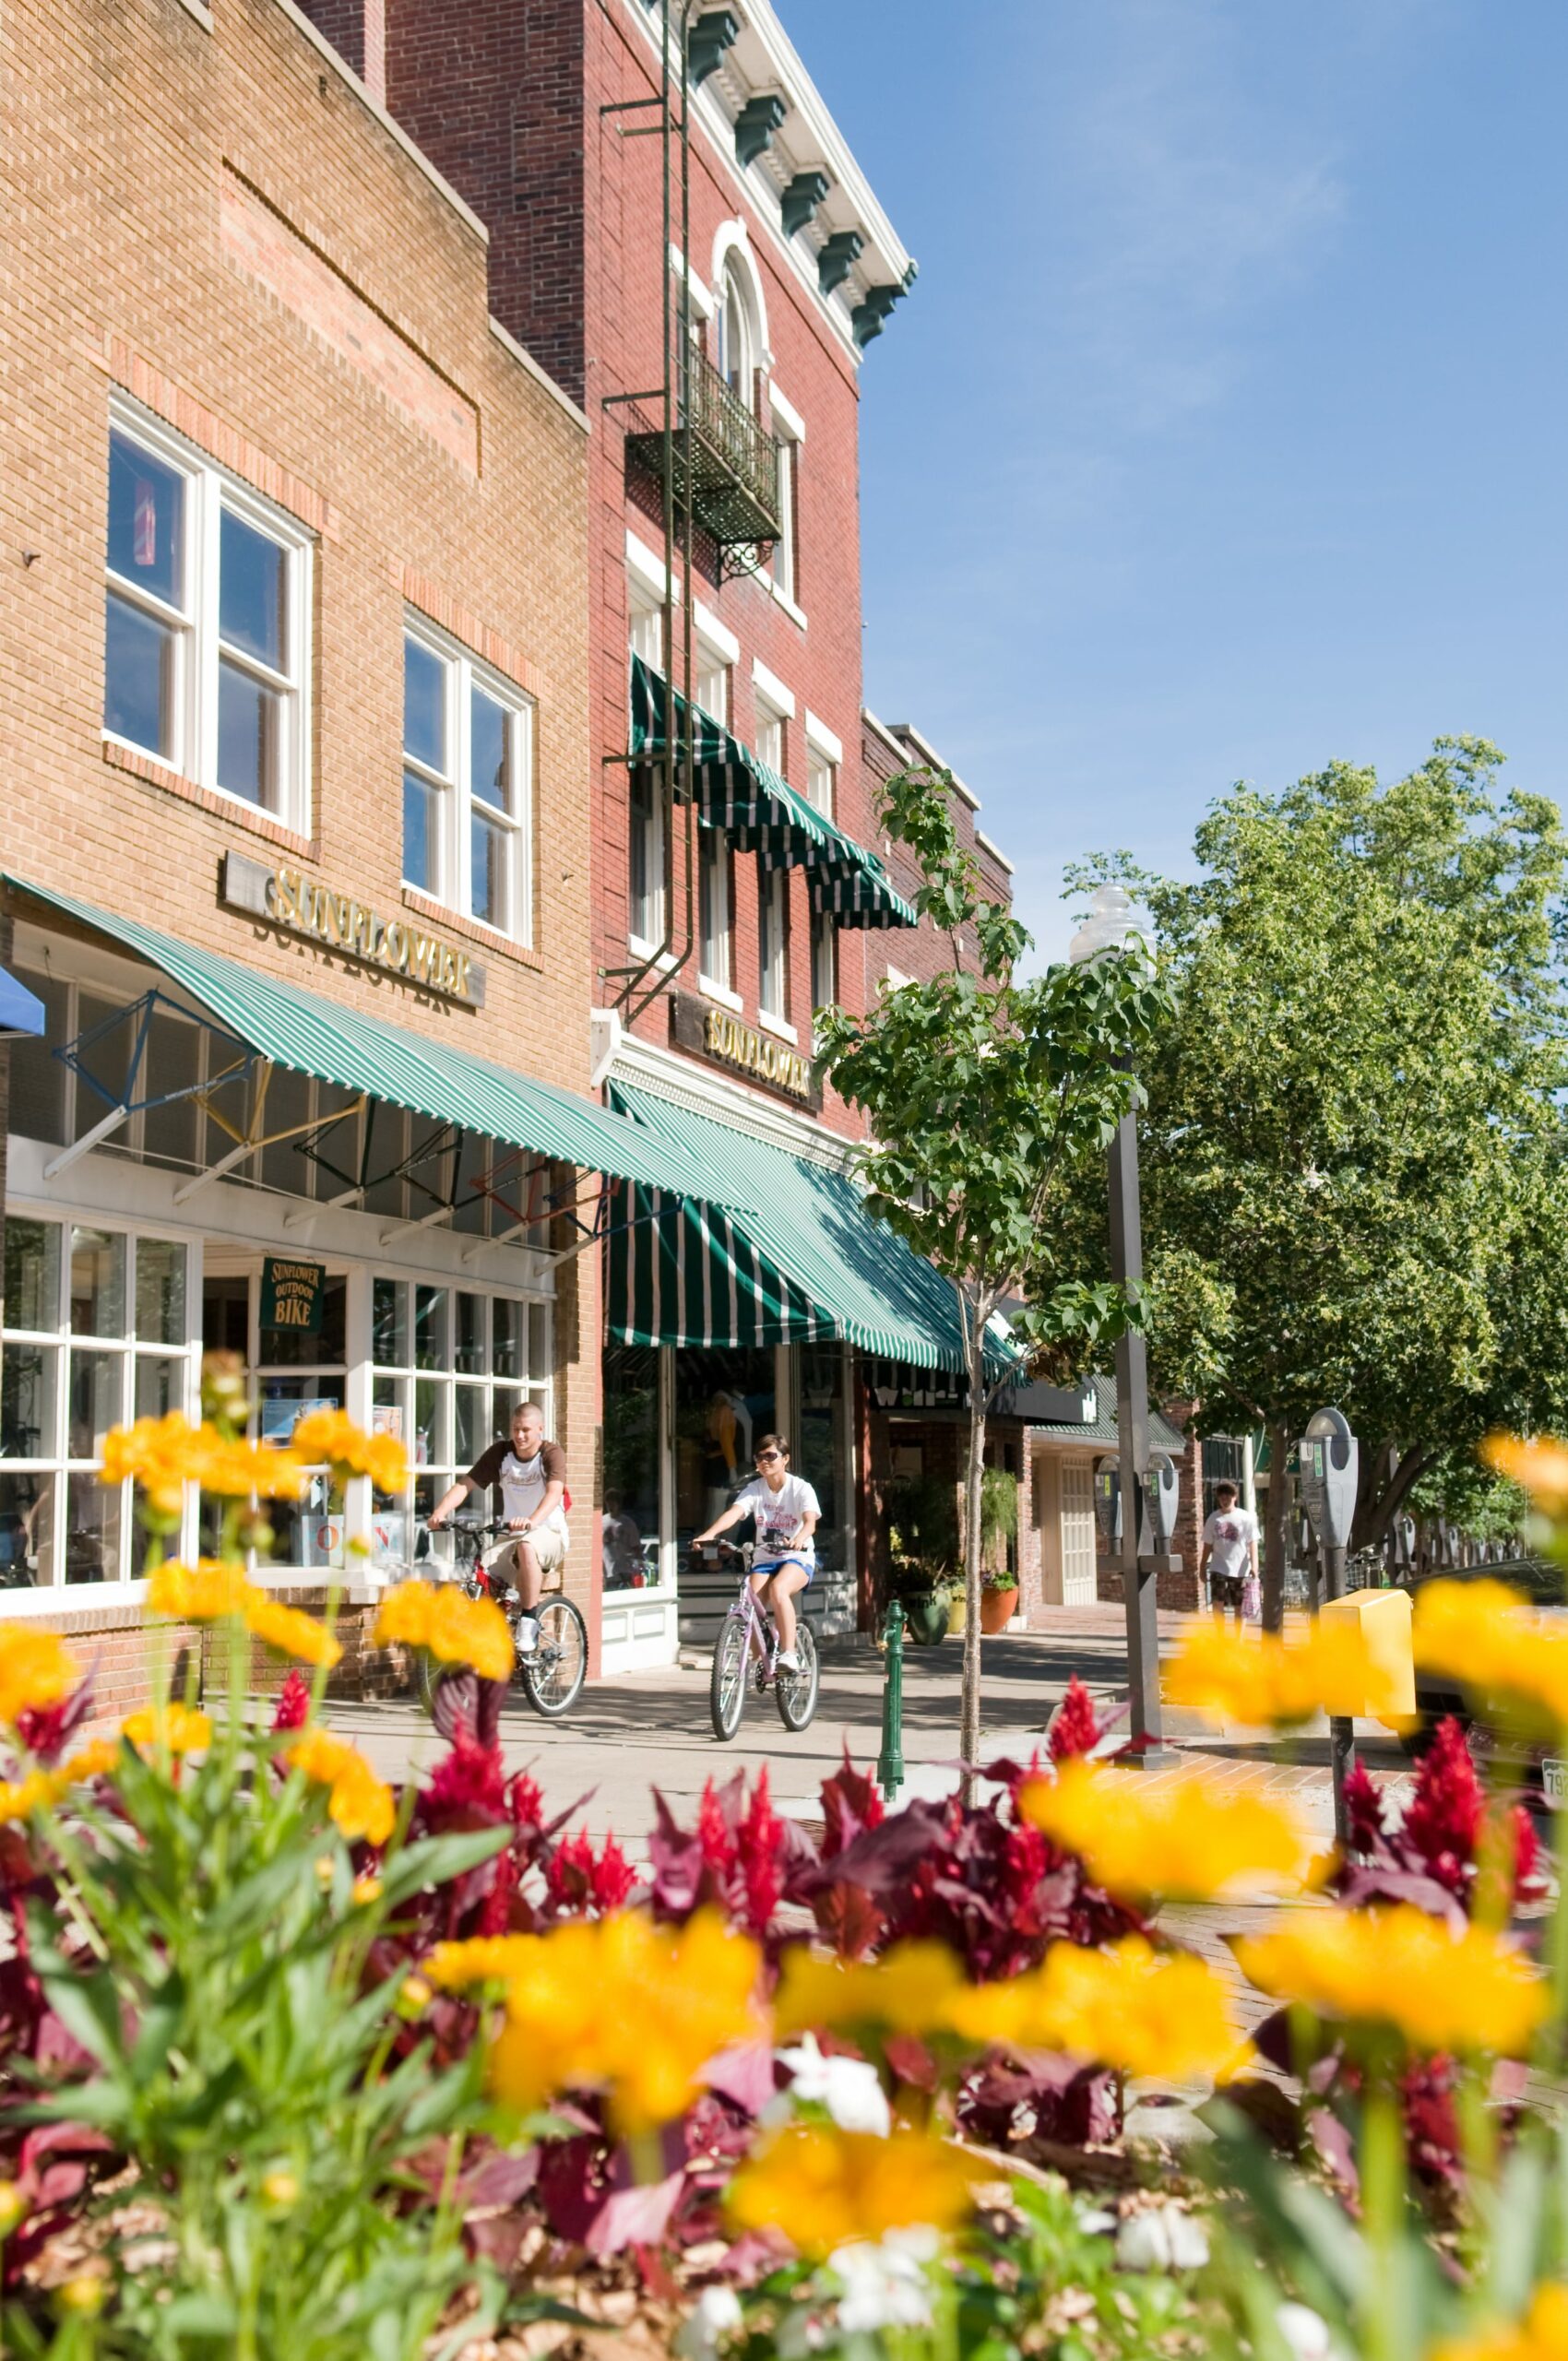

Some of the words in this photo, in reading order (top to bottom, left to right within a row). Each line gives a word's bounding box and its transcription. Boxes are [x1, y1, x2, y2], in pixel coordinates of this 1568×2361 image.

[272, 868, 473, 996] SUNFLOWER
[707, 1009, 811, 1097] SUNFLOWER
[271, 1262, 319, 1289] SUNFLOWER
[275, 1282, 315, 1300] OUTDOOR
[275, 1299, 311, 1326] BIKE
[315, 1524, 391, 1553] ON
